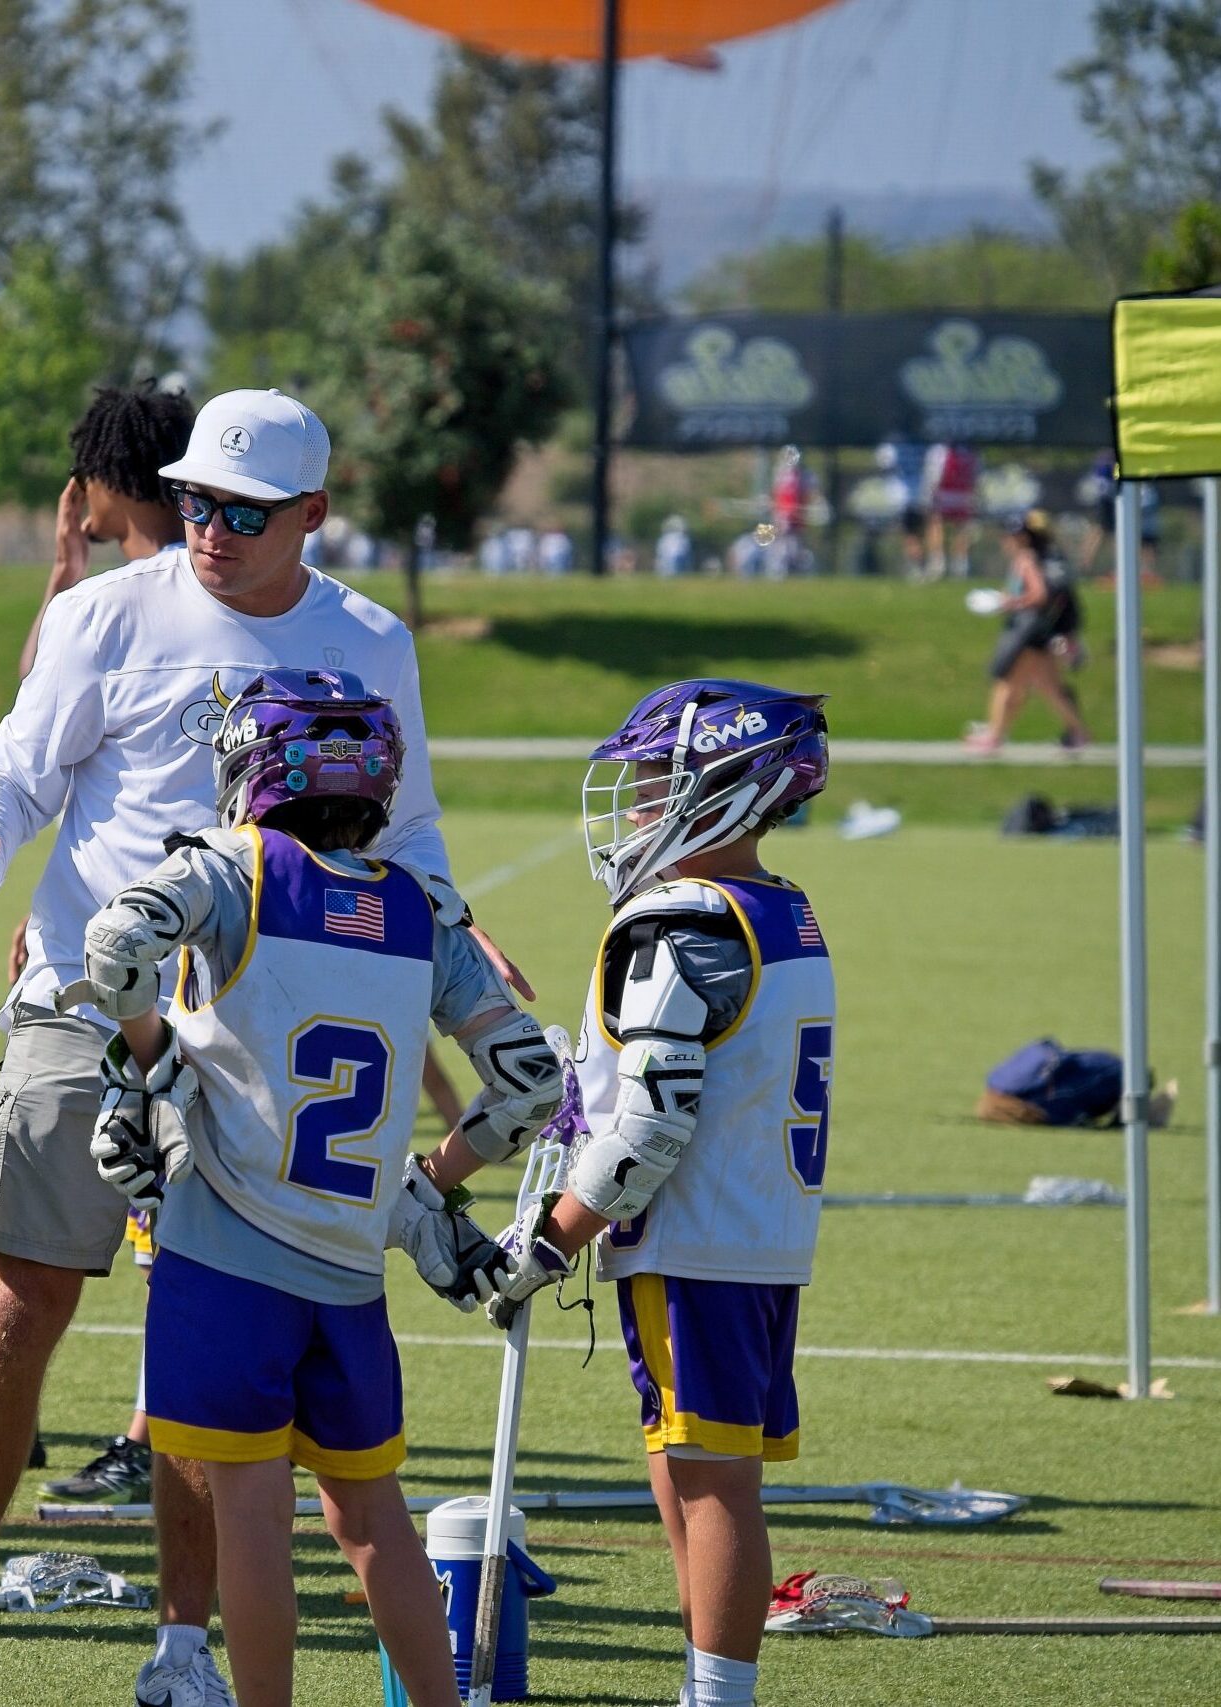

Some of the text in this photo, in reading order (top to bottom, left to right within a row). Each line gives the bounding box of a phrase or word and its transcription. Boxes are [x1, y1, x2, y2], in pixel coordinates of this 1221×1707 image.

[693, 711, 768, 754] GWB
[664, 1053, 699, 1062] CELL
[279, 1014, 395, 1209] 2
